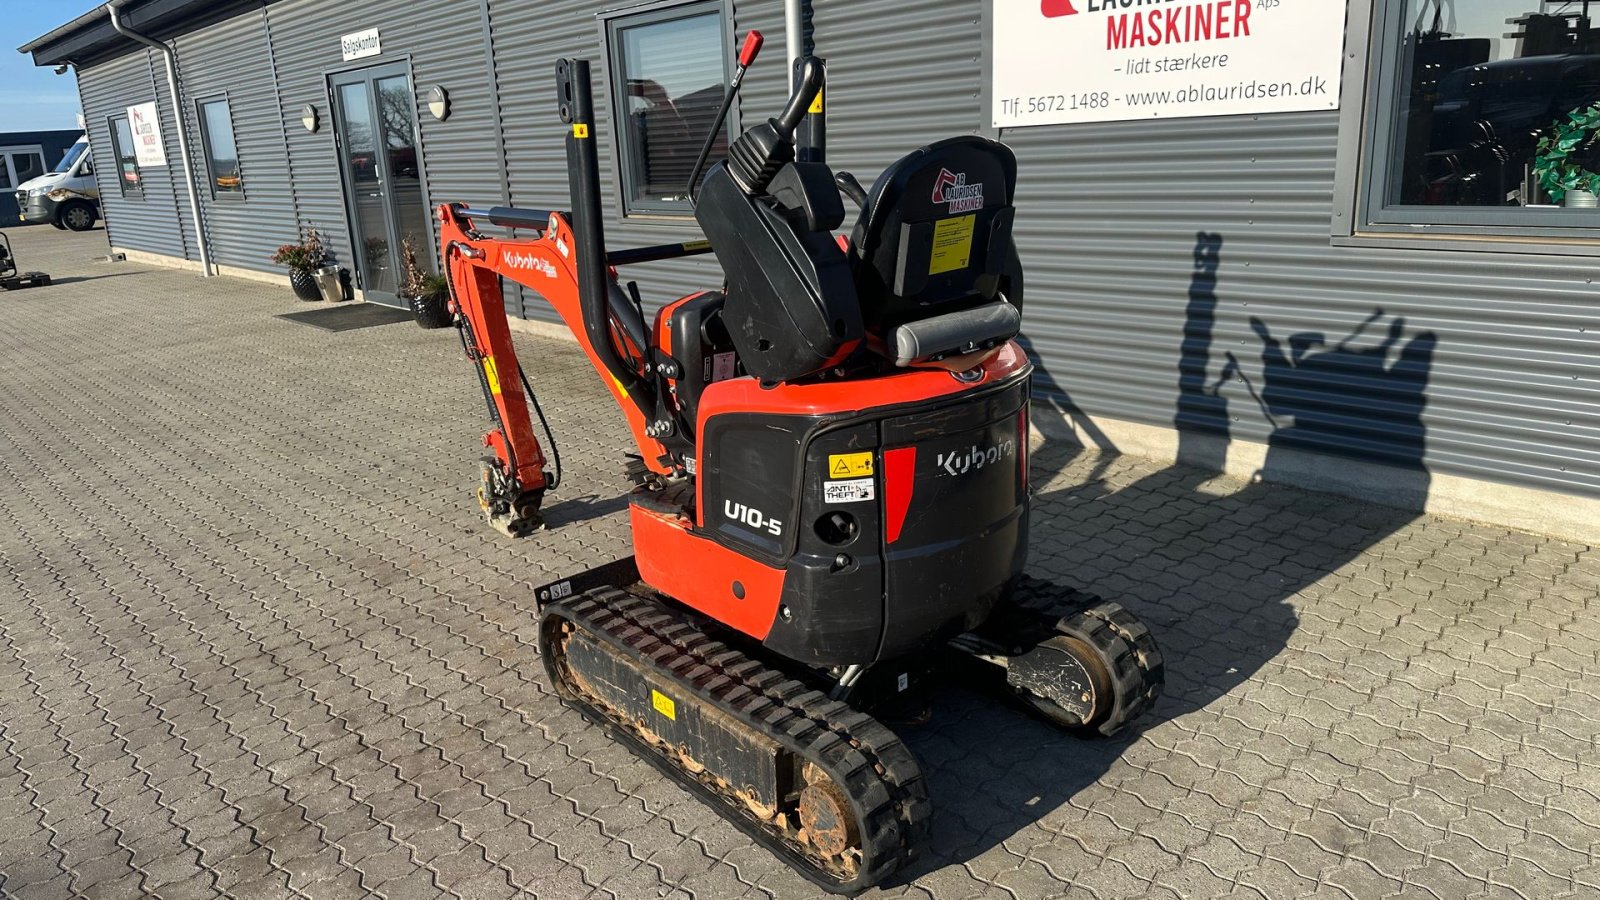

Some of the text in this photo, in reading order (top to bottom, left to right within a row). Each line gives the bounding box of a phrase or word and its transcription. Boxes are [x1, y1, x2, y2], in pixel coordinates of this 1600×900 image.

[1106, 0, 1251, 50] MASKINER
[343, 35, 377, 55] Salgskontor
[1126, 58, 1151, 75] lidt
[1154, 53, 1229, 73] stærkere
[1001, 96, 1023, 118] Tlf.
[1027, 94, 1065, 113] 5672
[1069, 91, 1110, 111] 1488
[1125, 76, 1327, 106] www.ablauridsen.dk
[946, 183, 983, 202] LAURIDSEN
[949, 196, 984, 213] MASKINER
[503, 251, 541, 271] Kubota
[826, 491, 855, 499] THEFT
[724, 499, 782, 536] U10-5
